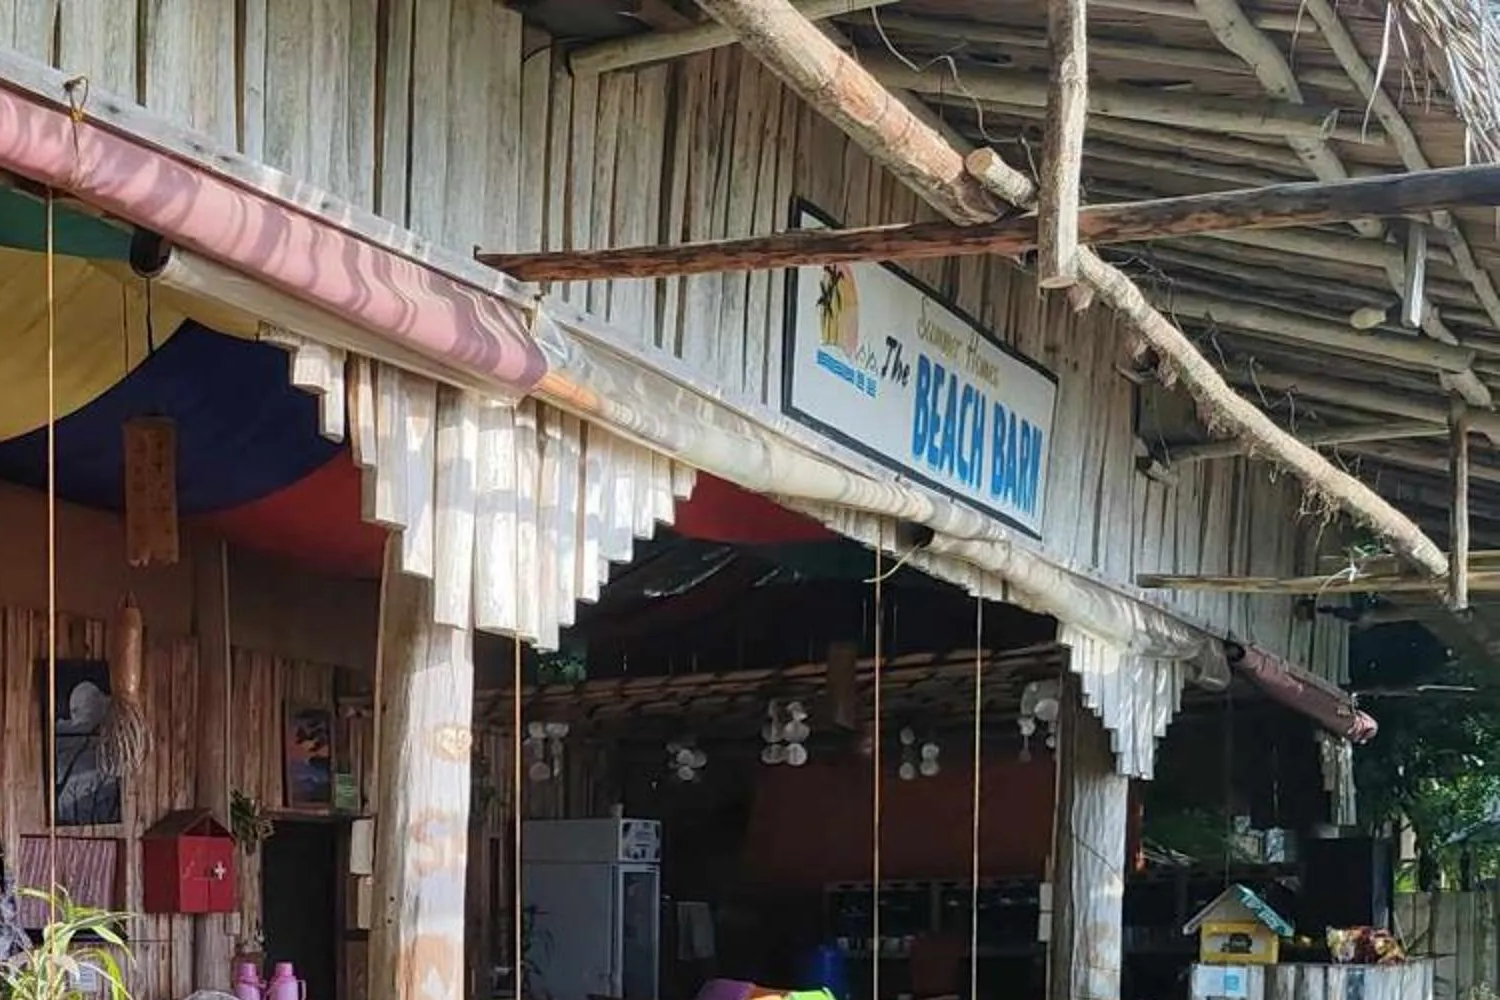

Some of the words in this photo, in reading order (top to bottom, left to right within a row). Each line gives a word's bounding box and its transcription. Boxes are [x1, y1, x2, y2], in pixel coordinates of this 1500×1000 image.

[881, 336, 910, 387] The
[912, 354, 986, 488] BEACH
[992, 403, 1042, 517] BARN
